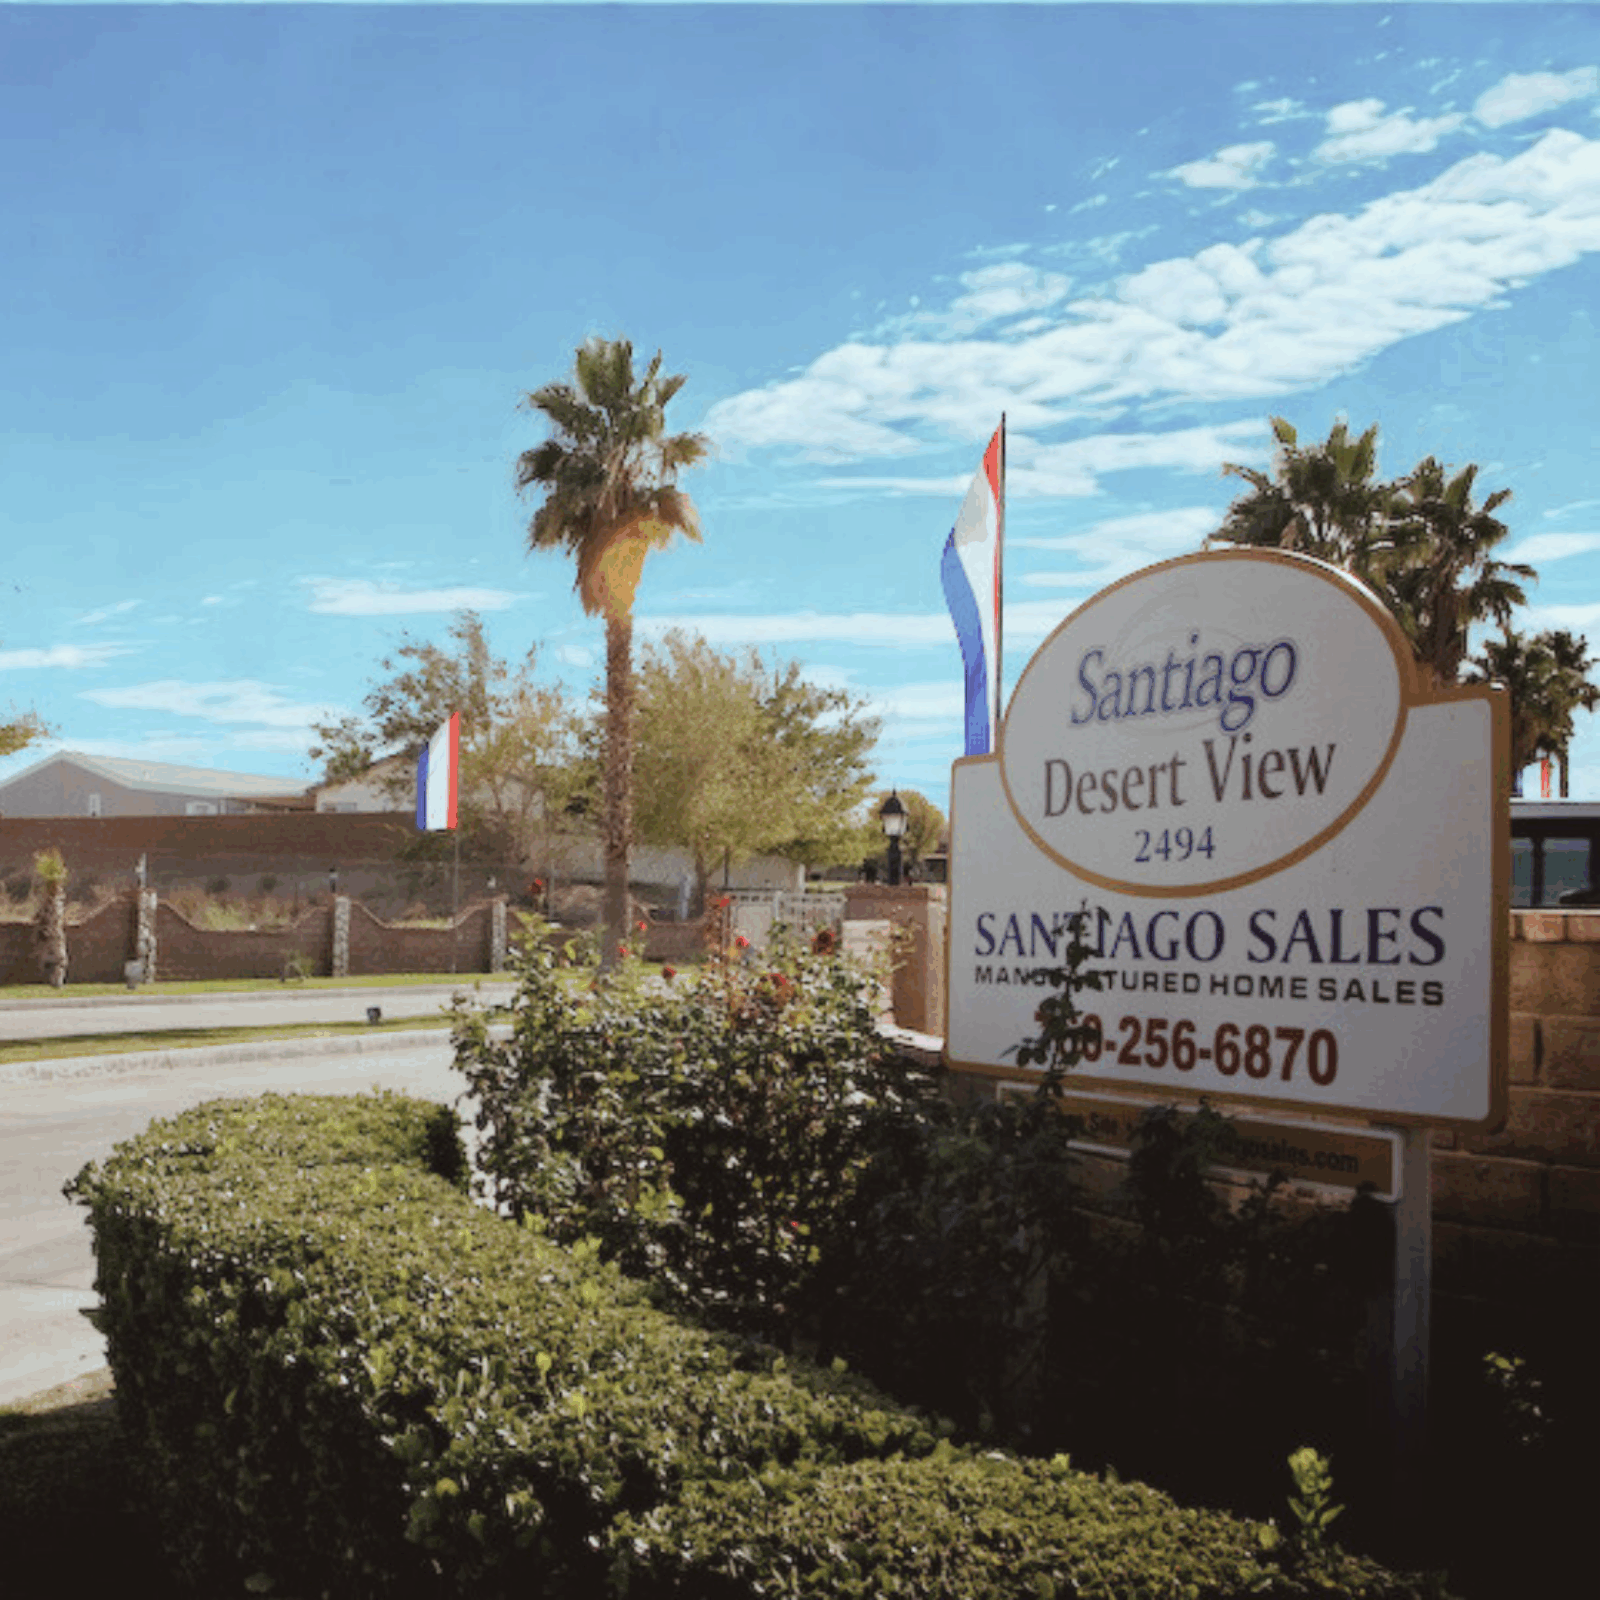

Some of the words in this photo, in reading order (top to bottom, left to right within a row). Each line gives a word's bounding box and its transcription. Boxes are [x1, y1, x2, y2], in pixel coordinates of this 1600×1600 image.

[1071, 629, 1296, 731] Santiago
[1043, 752, 1187, 817] Desert
[1202, 732, 1337, 802] View
[1133, 825, 1217, 863] 2494
[974, 909, 1225, 961] SANIAGO
[1247, 905, 1446, 966] SALES
[973, 965, 1200, 993] MANUTURED
[1209, 973, 1308, 999] HOME
[1318, 977, 1445, 1006] SALES
[1034, 1011, 1339, 1087] 0-256-6870
